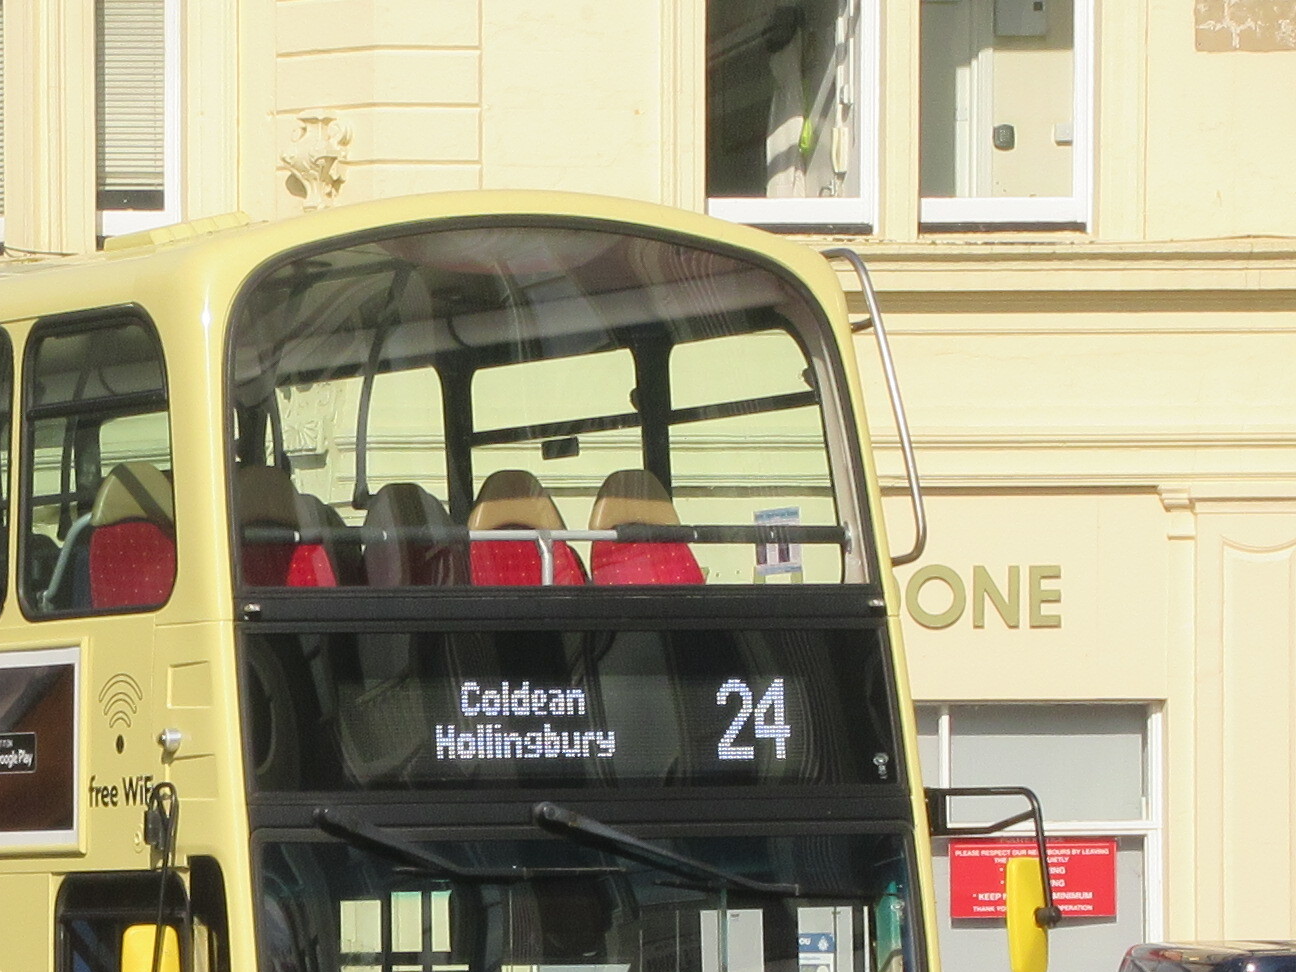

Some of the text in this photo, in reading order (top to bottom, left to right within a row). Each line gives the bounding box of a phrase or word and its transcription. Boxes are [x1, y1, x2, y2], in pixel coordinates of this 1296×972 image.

[894, 564, 1062, 629] ONE
[460, 681, 586, 717] Coldean
[716, 678, 791, 760] 24
[18, 748, 34, 767] Play
[435, 723, 616, 760] Hollingbury
[88, 774, 155, 808] free WiF
[955, 849, 980, 857] PLEASE
[980, 848, 1011, 856] RESPECT
[1082, 847, 1109, 855] LEAVING
[972, 905, 995, 913] THANK
[978, 891, 1093, 901] KEEP MINIMUM
